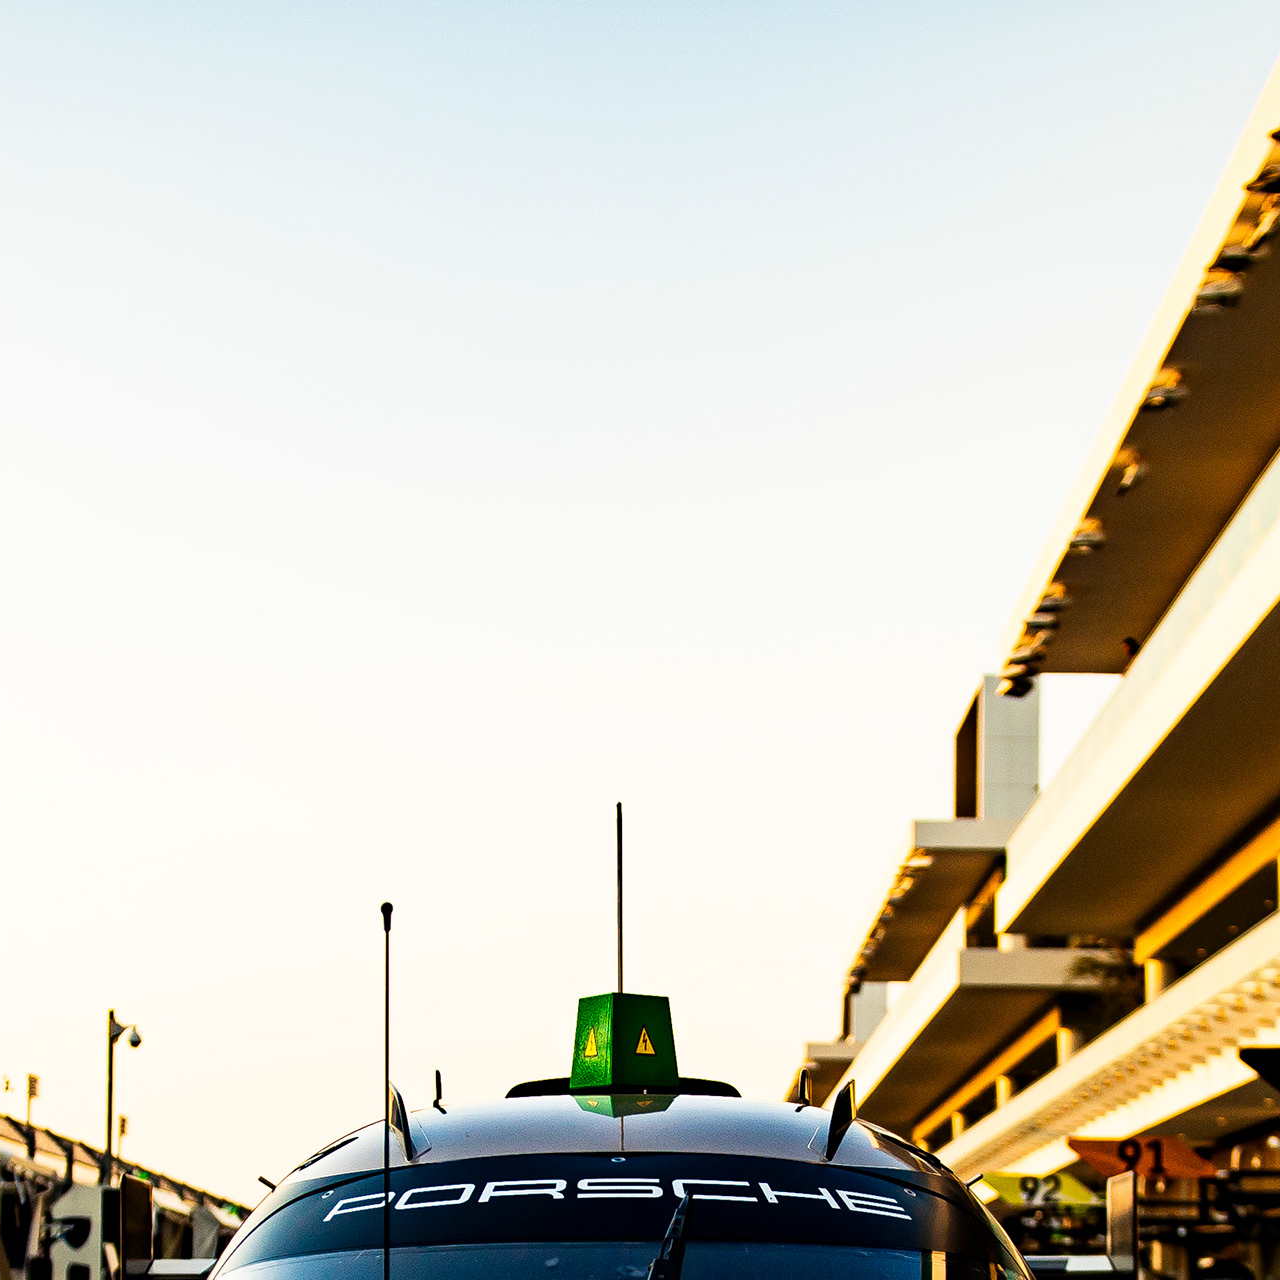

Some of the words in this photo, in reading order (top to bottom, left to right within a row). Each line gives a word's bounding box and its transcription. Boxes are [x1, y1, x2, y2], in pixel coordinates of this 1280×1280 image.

[1117, 1139, 1166, 1174] 91
[324, 1177, 912, 1222] PORSCHE
[1020, 1175, 1062, 1202] 92
